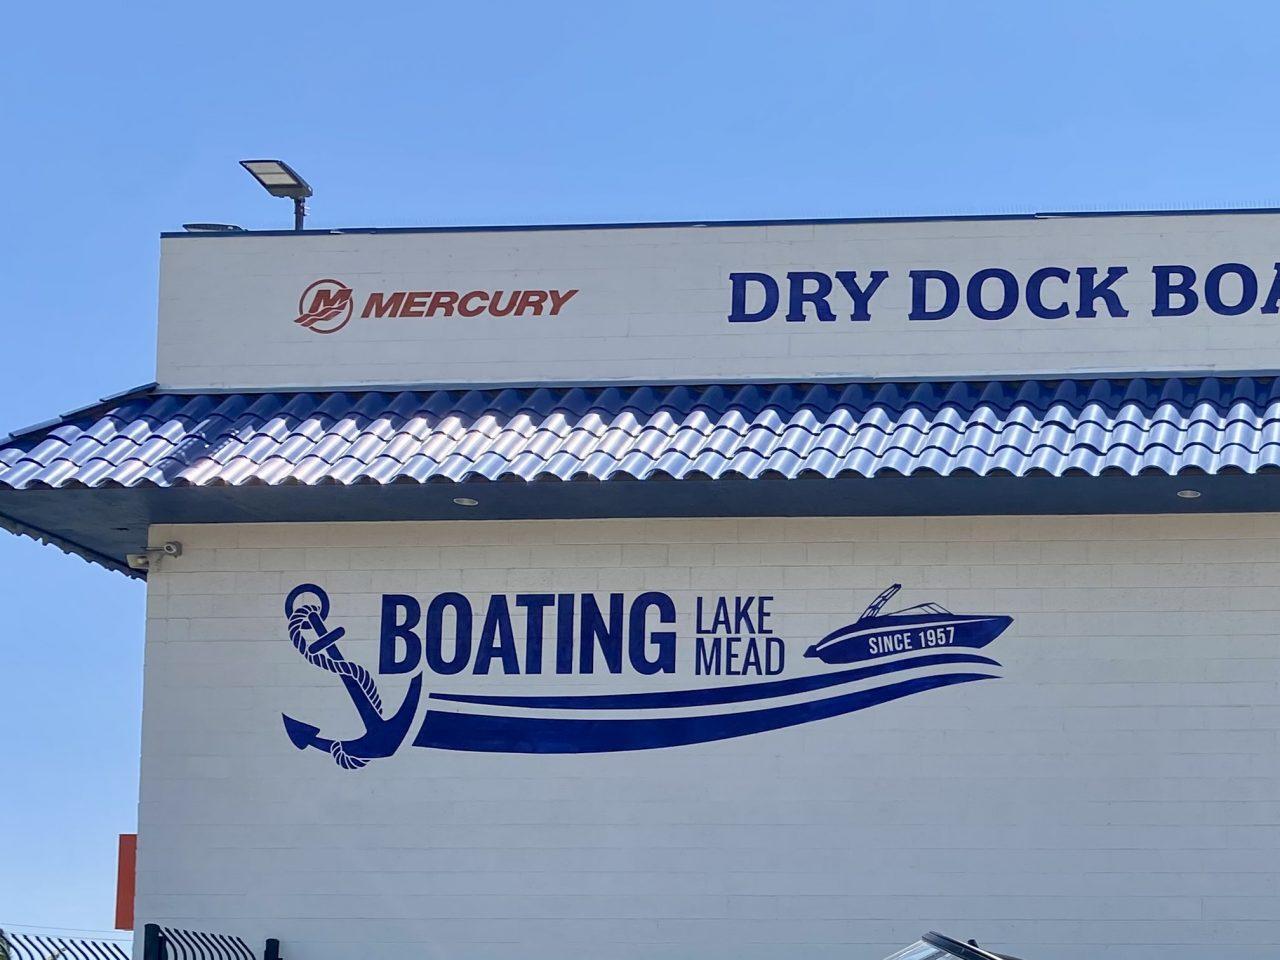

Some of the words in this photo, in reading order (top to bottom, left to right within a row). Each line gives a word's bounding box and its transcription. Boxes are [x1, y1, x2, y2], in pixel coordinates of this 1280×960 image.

[361, 289, 579, 318] MERCURY
[728, 270, 889, 323] DRY
[908, 266, 1129, 321] DOCK
[379, 591, 677, 675] BOATING
[696, 596, 774, 634] LAKE
[695, 637, 785, 675] MEAD
[868, 632, 913, 654] SINCE
[918, 626, 955, 648] 1957
